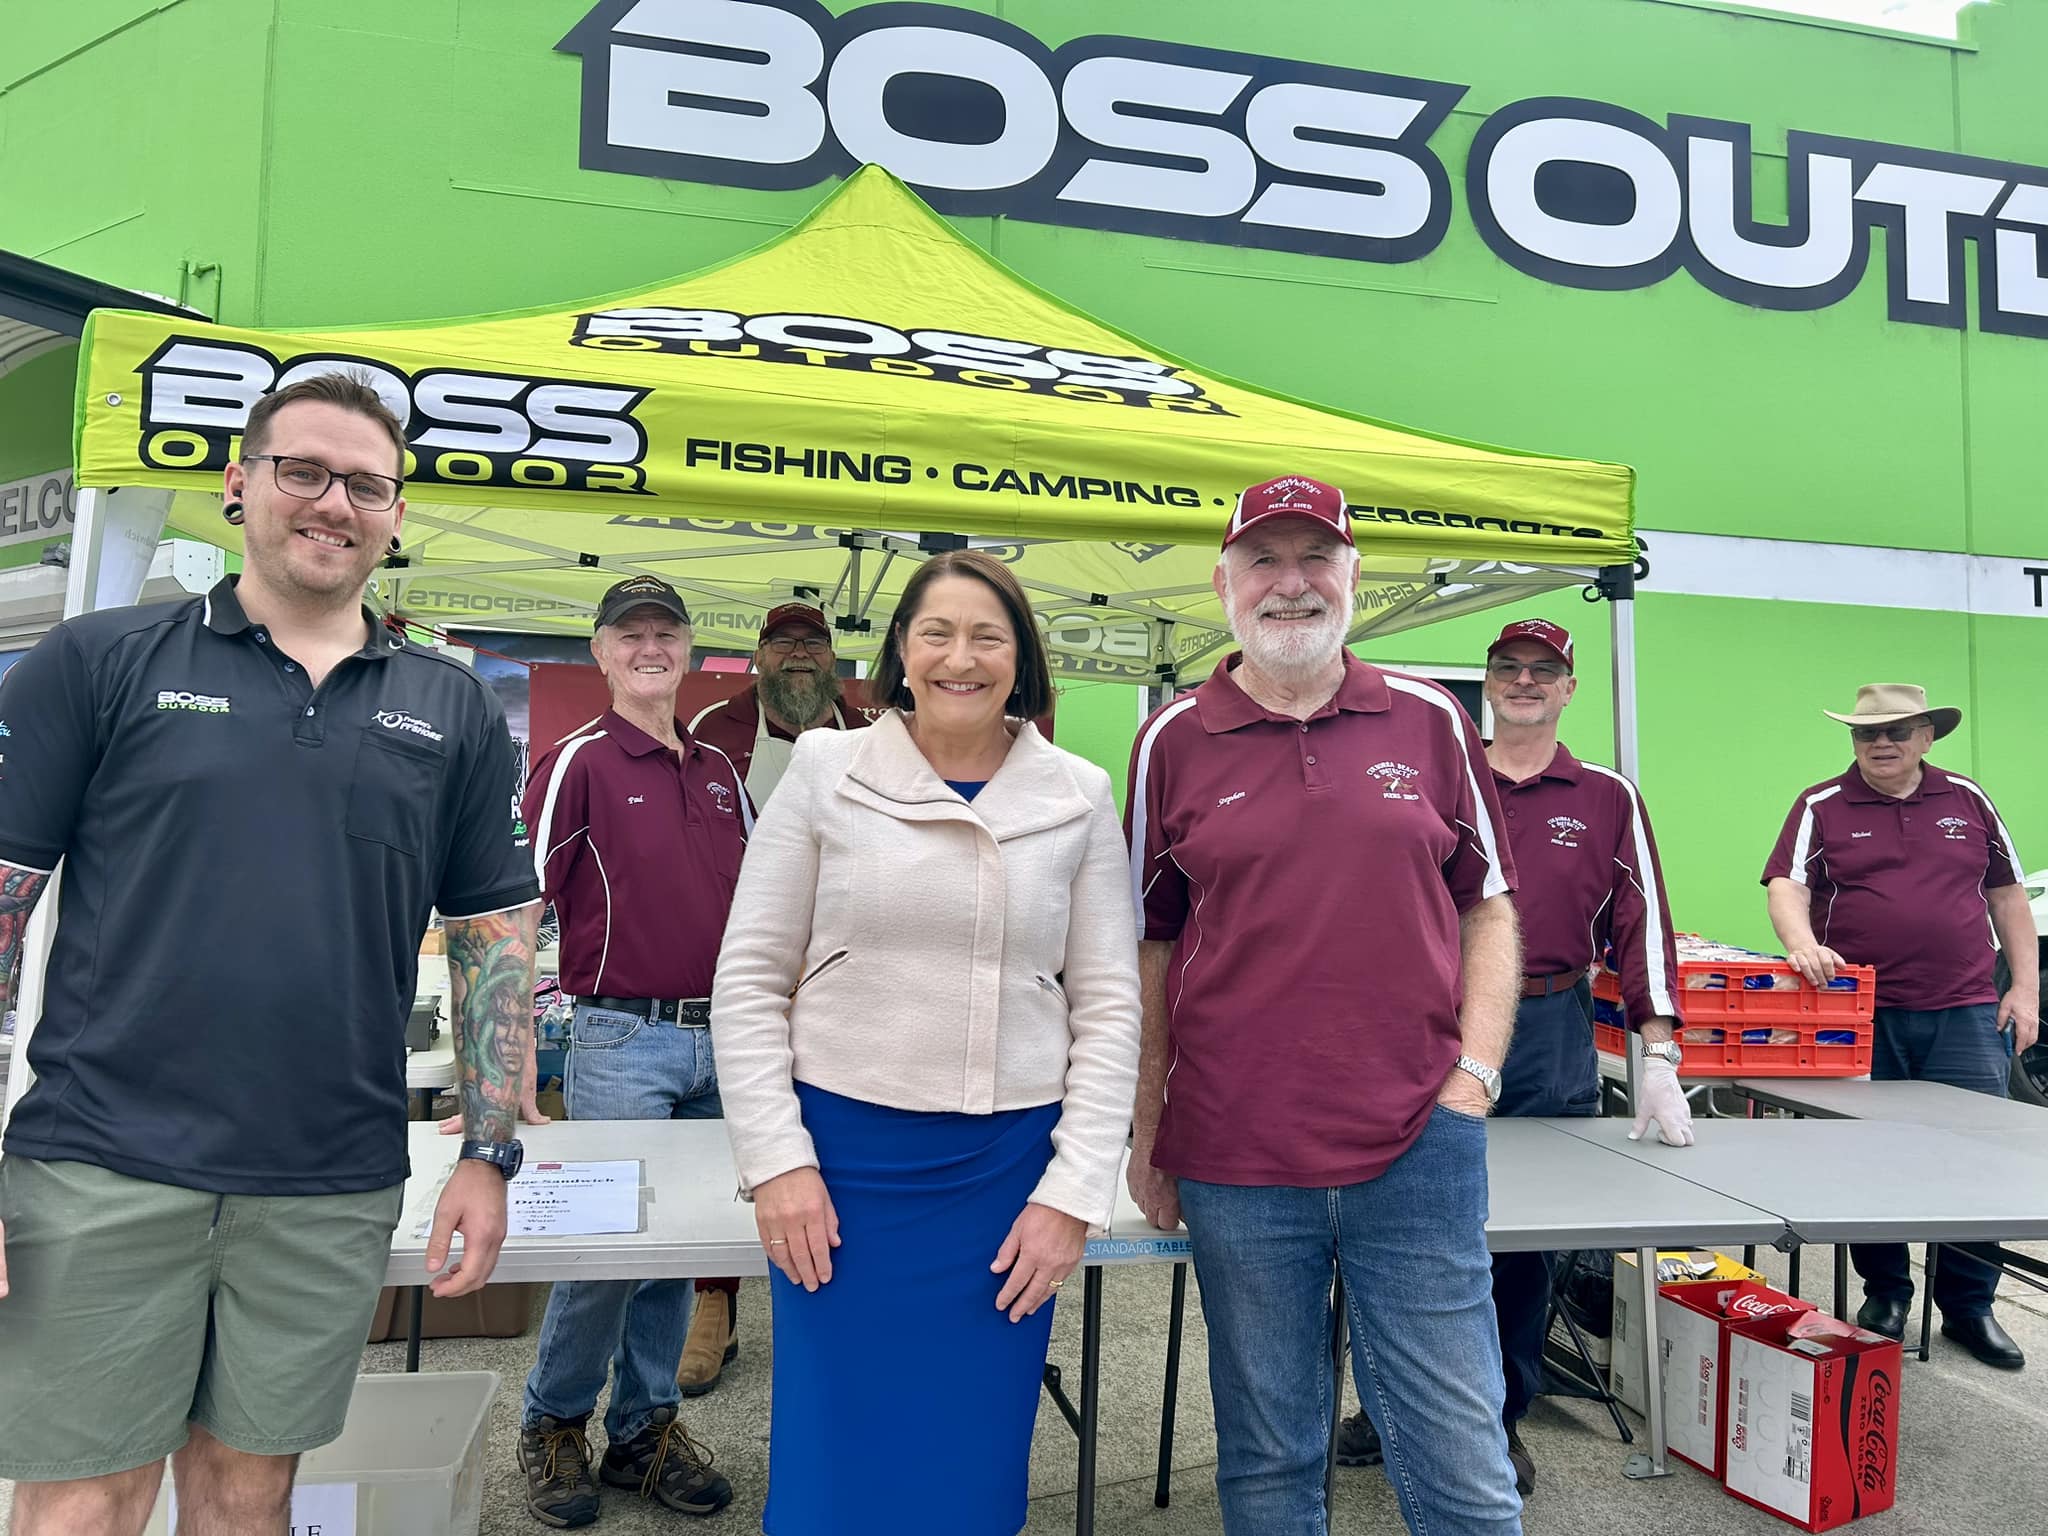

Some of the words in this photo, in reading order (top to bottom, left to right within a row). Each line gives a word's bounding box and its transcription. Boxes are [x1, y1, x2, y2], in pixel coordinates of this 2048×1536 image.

[607, 0, 1431, 239] BOSS
[581, 336, 1223, 415] OUTDOOR
[586, 308, 1195, 396] BOSS
[148, 430, 638, 492] OOOR
[686, 438, 911, 484] FISHING
[953, 463, 1201, 508] CAMPING
[157, 703, 230, 713] OUTDOOR
[158, 691, 230, 708] BOSS
[1089, 1241, 1152, 1255] STANDARD
[1859, 1396, 1867, 1431] ZERO
[1864, 1369, 1892, 1494] Coca-Cola
[1857, 1435, 1866, 1481] SUGAR
